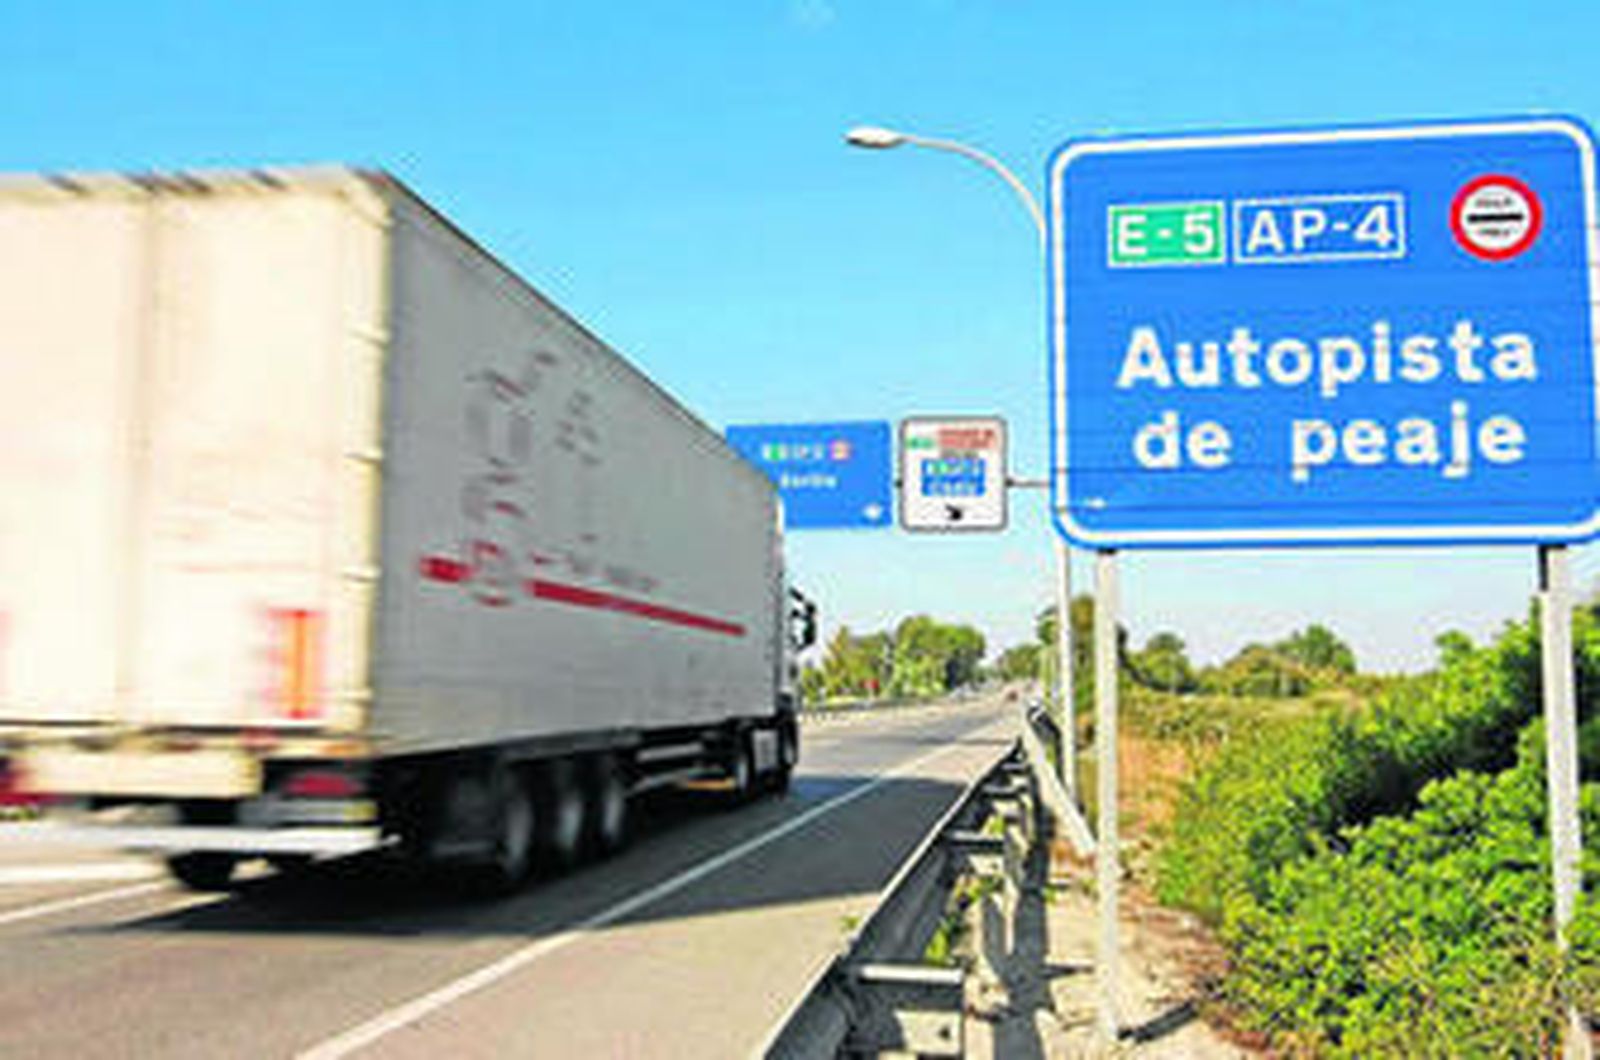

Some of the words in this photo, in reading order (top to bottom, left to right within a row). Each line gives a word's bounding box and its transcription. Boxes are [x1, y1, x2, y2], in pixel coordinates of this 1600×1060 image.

[1117, 212, 1216, 255] E-5
[1245, 205, 1395, 253] AP-4
[1117, 321, 1540, 398] Autopista
[1133, 411, 1232, 469] de
[1291, 401, 1528, 482] peaje
